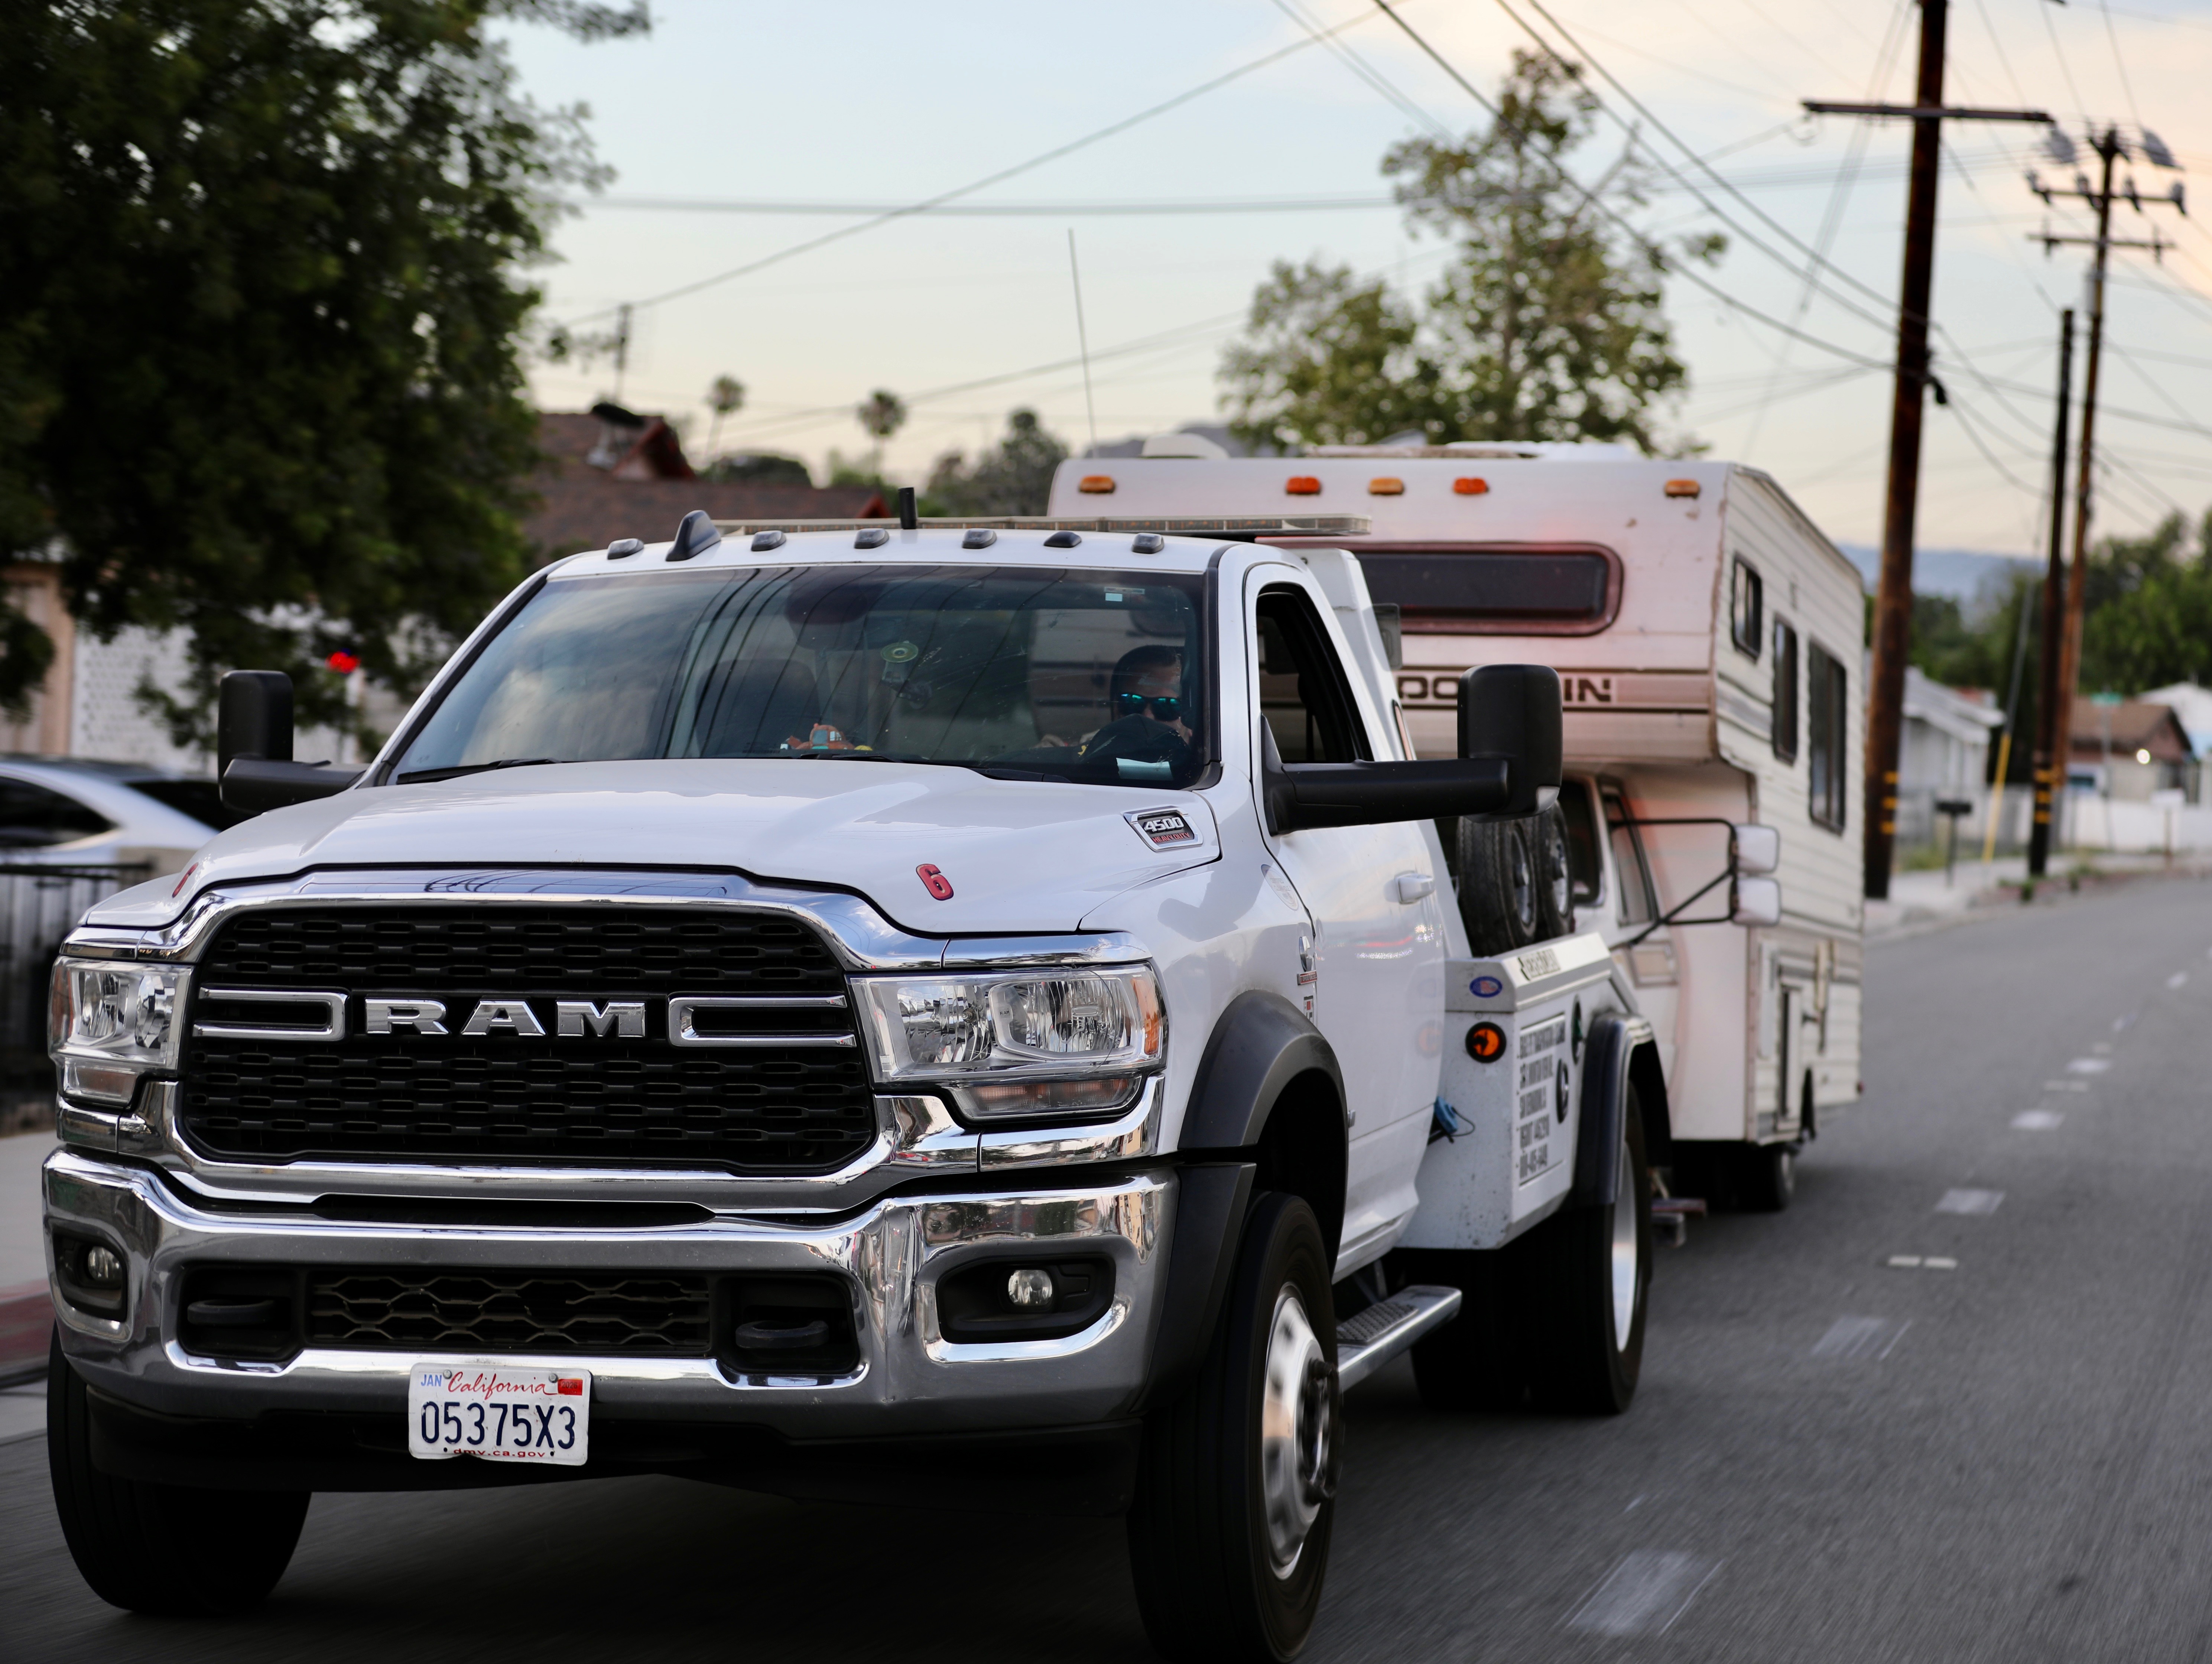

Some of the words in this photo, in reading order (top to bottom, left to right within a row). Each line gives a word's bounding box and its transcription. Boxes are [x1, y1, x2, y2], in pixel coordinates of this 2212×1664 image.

[1398, 677, 1611, 702] DOIN
[1144, 817, 1184, 832] 4500
[1152, 833, 1174, 843] HEAVY
[916, 864, 954, 901] 6
[365, 997, 646, 1037] RAM
[421, 1374, 442, 1387] JAN
[448, 1371, 558, 1400] California
[421, 1401, 575, 1449] 05375X3
[454, 1448, 545, 1457] dmv.ca.gov
